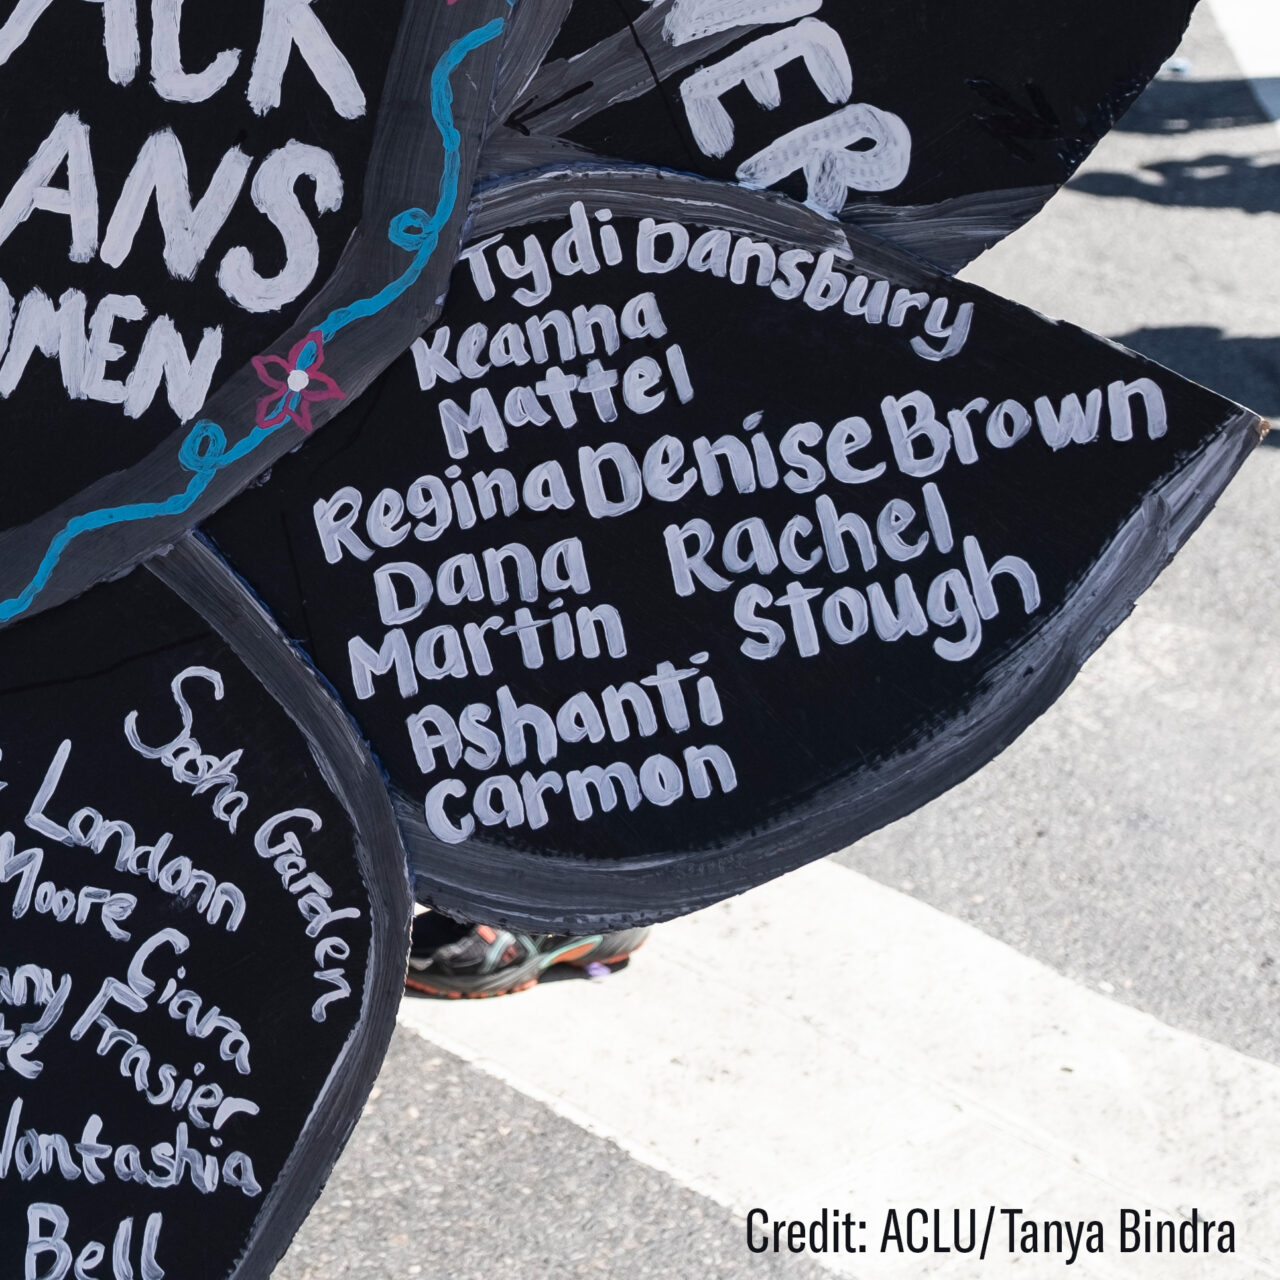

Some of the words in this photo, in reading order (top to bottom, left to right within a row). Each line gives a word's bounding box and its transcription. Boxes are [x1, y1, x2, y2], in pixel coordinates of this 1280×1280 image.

[410, 290, 670, 392] Keanna
[460, 201, 624, 307] Tydi
[635, 215, 975, 362] Dansbury
[437, 342, 694, 460] Mattel
[313, 460, 577, 565] Regina
[577, 410, 888, 520] Denise
[880, 376, 1169, 480] Brown
[374, 536, 592, 626] Dana
[662, 481, 955, 598] Rachel
[732, 533, 1042, 663] Stough
[346, 596, 627, 701] Martin
[405, 650, 725, 775] Ashanti
[24, 739, 247, 933] Londonn
[423, 741, 739, 845] Carmon
[253, 807, 361, 1023] Garden
[70, 976, 261, 1130] Frasier
[126, 927, 252, 1075] Ciara
[24, 1202, 166, 1280] Bell
